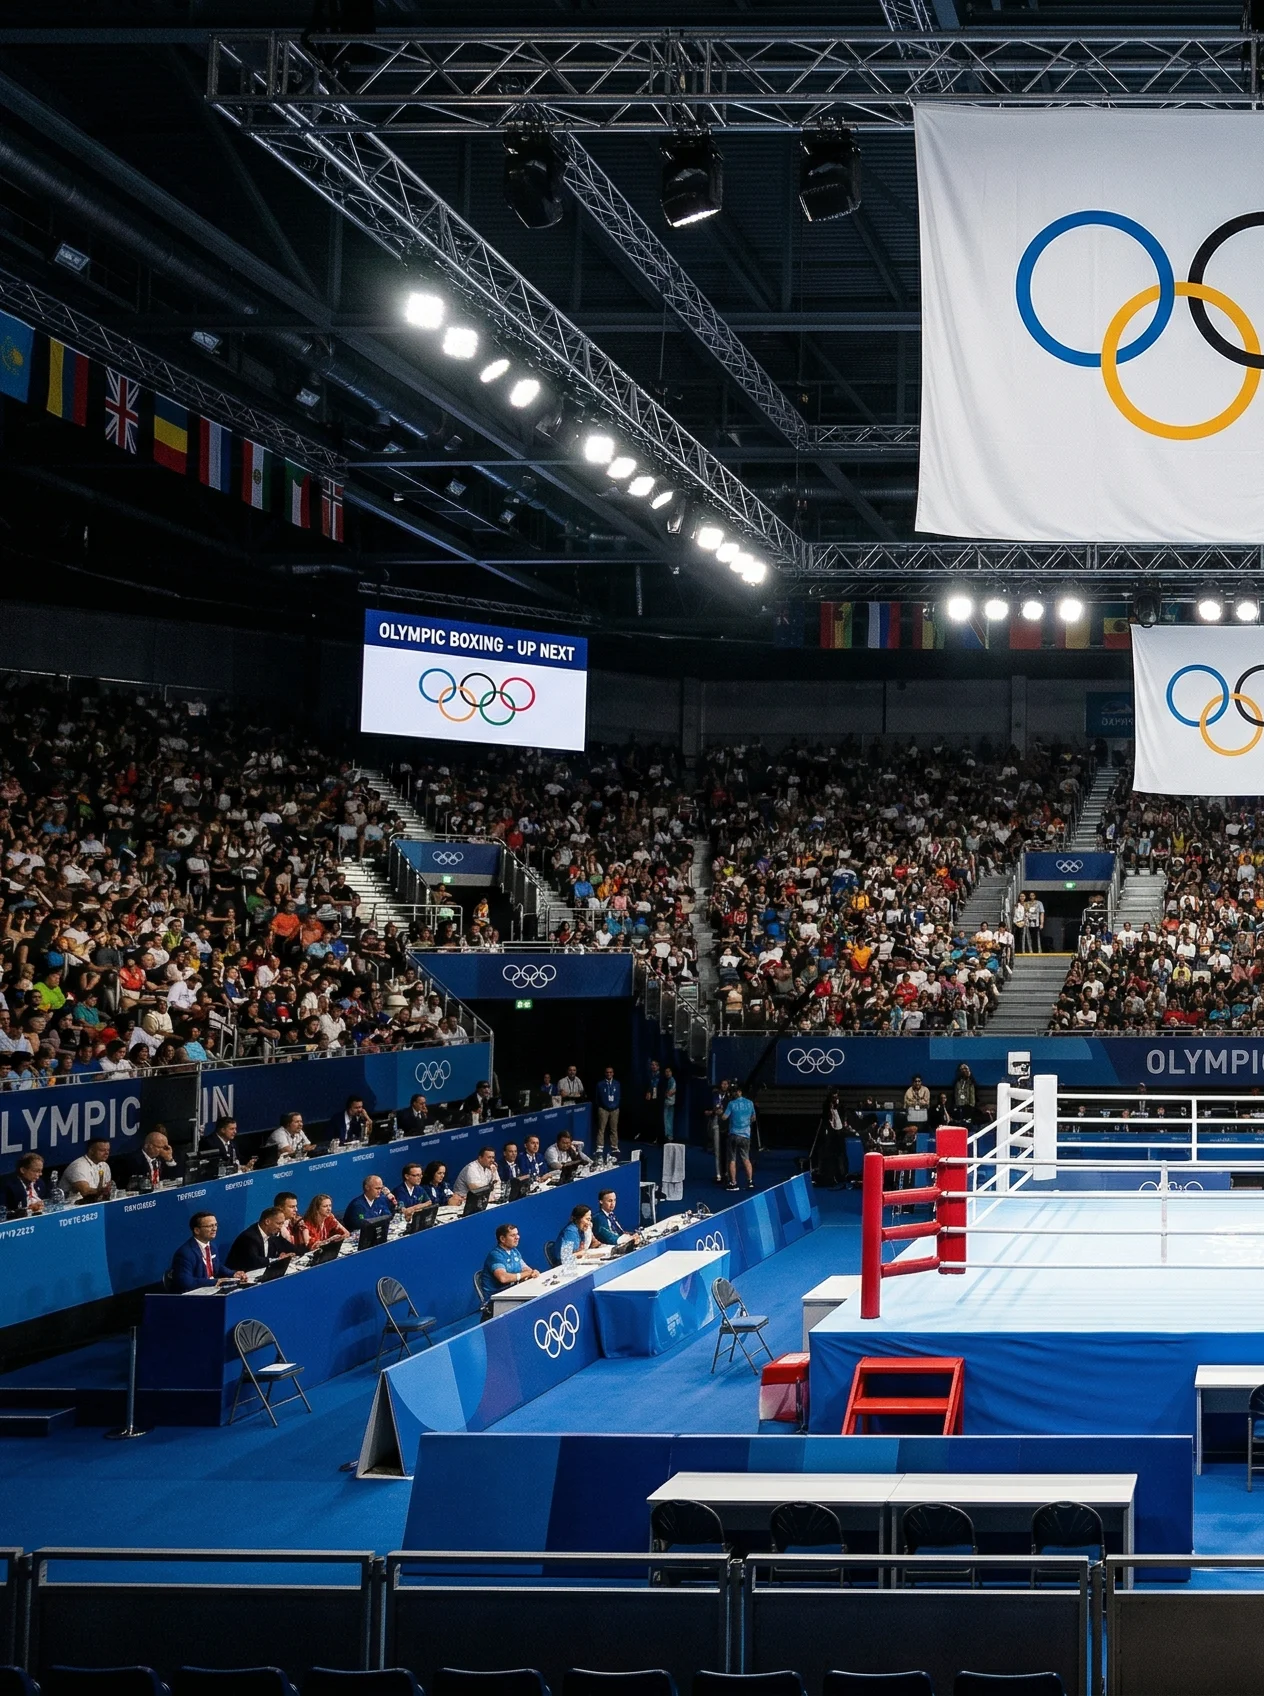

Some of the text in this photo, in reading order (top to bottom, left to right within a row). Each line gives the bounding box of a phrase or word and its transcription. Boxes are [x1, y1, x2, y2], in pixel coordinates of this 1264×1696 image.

[379, 622, 446, 646] OLYMPIC
[449, 631, 504, 653] BOXING
[517, 639, 536, 657] UP
[540, 643, 575, 662] NEXT
